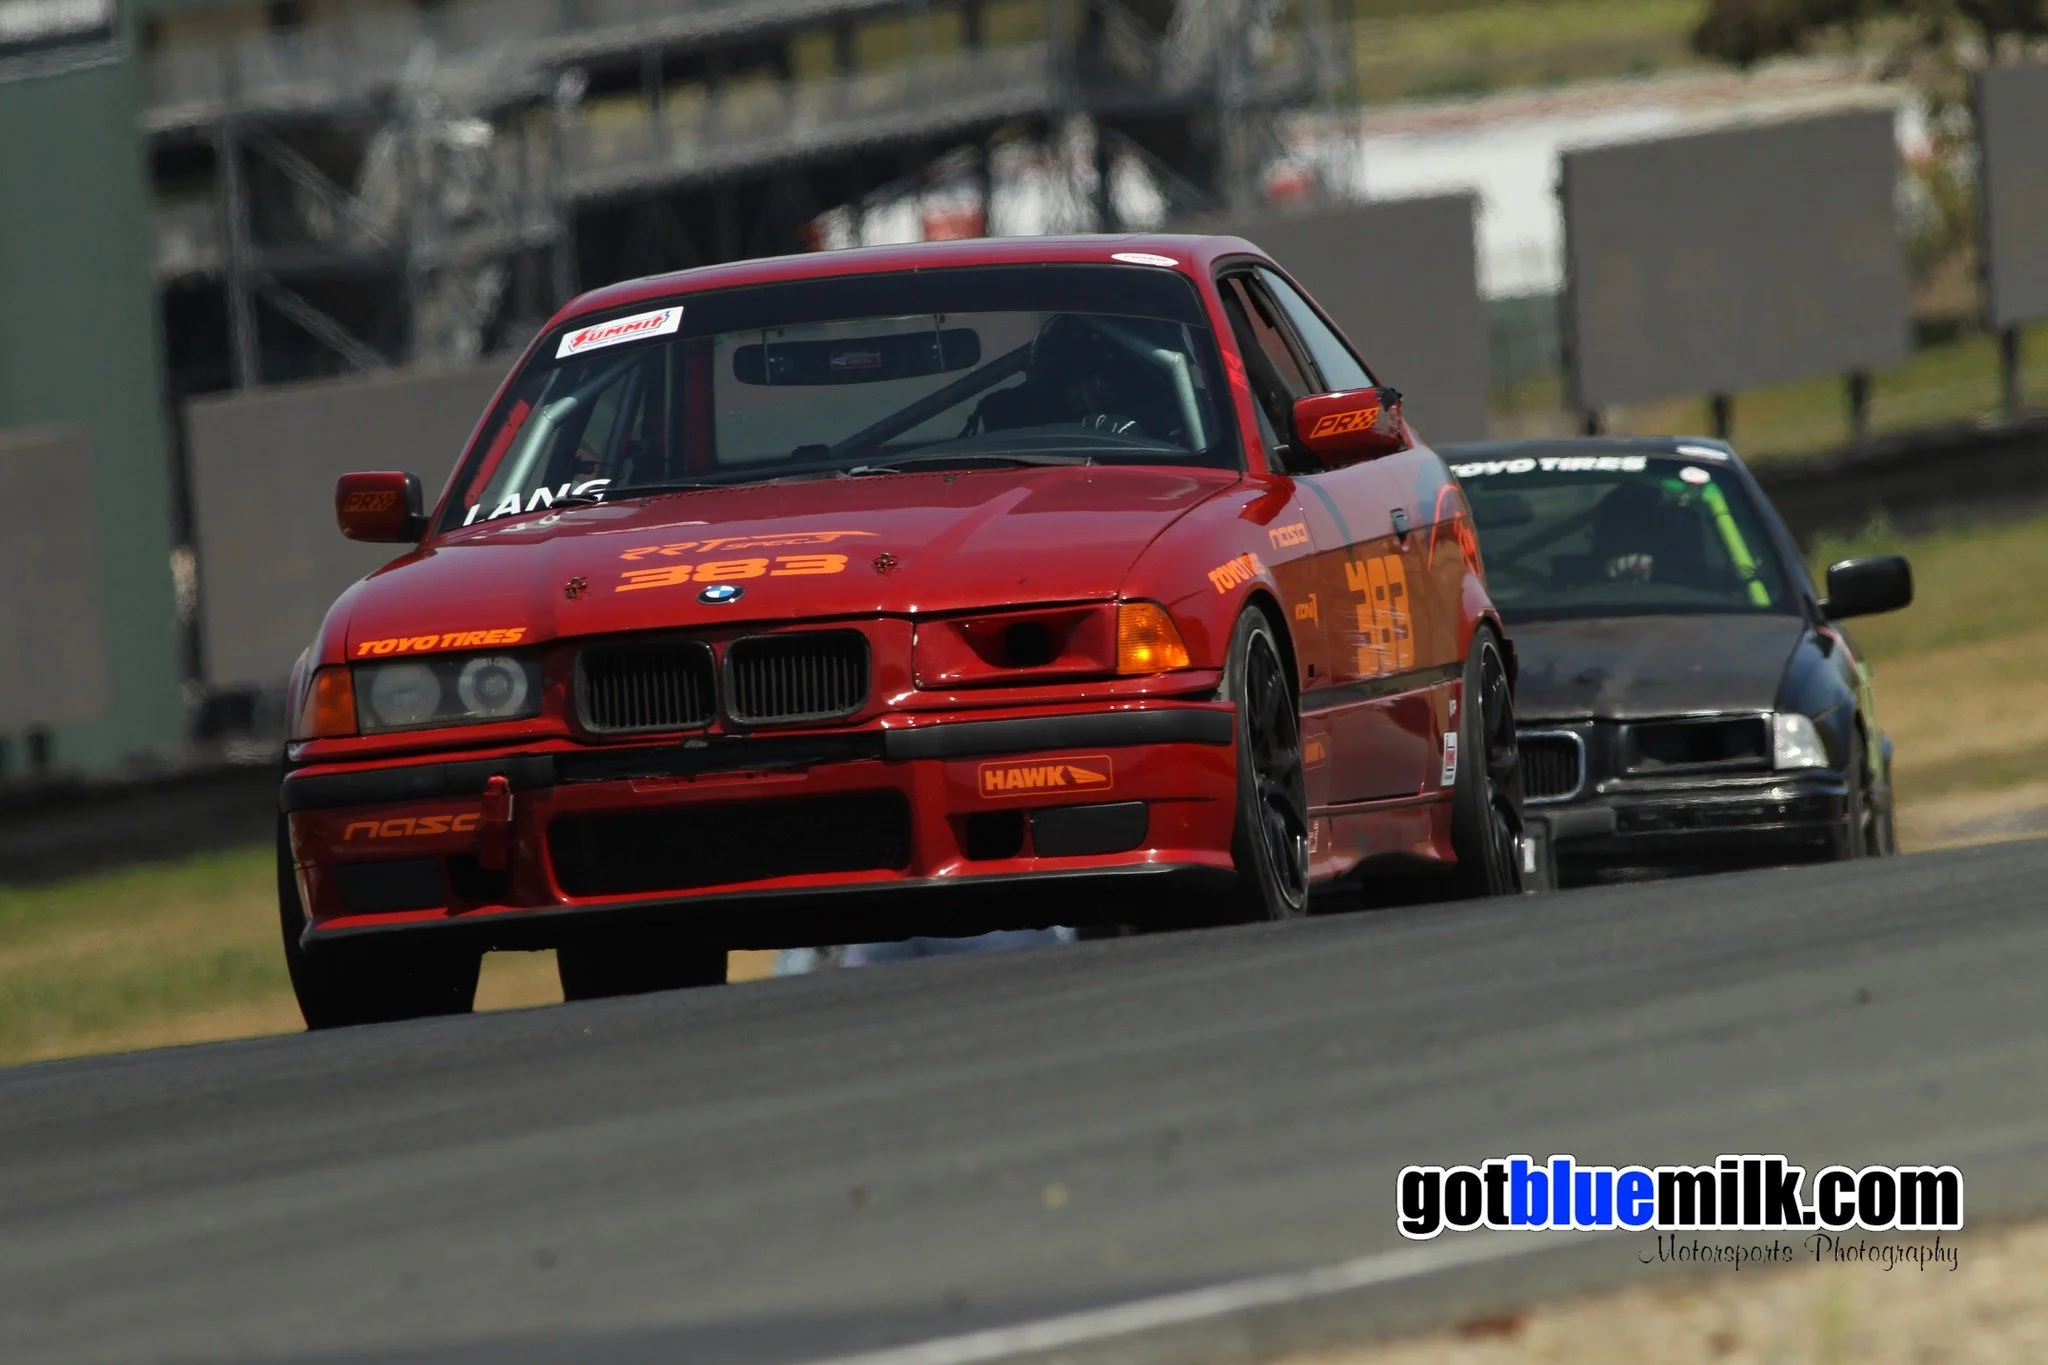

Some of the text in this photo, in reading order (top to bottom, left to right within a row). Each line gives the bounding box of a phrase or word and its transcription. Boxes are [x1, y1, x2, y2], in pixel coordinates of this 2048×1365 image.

[1537, 455, 1647, 472] TIRES
[615, 554, 848, 592] 383
[357, 627, 528, 656] TOYO TIRES
[985, 765, 1067, 790] HAWK
